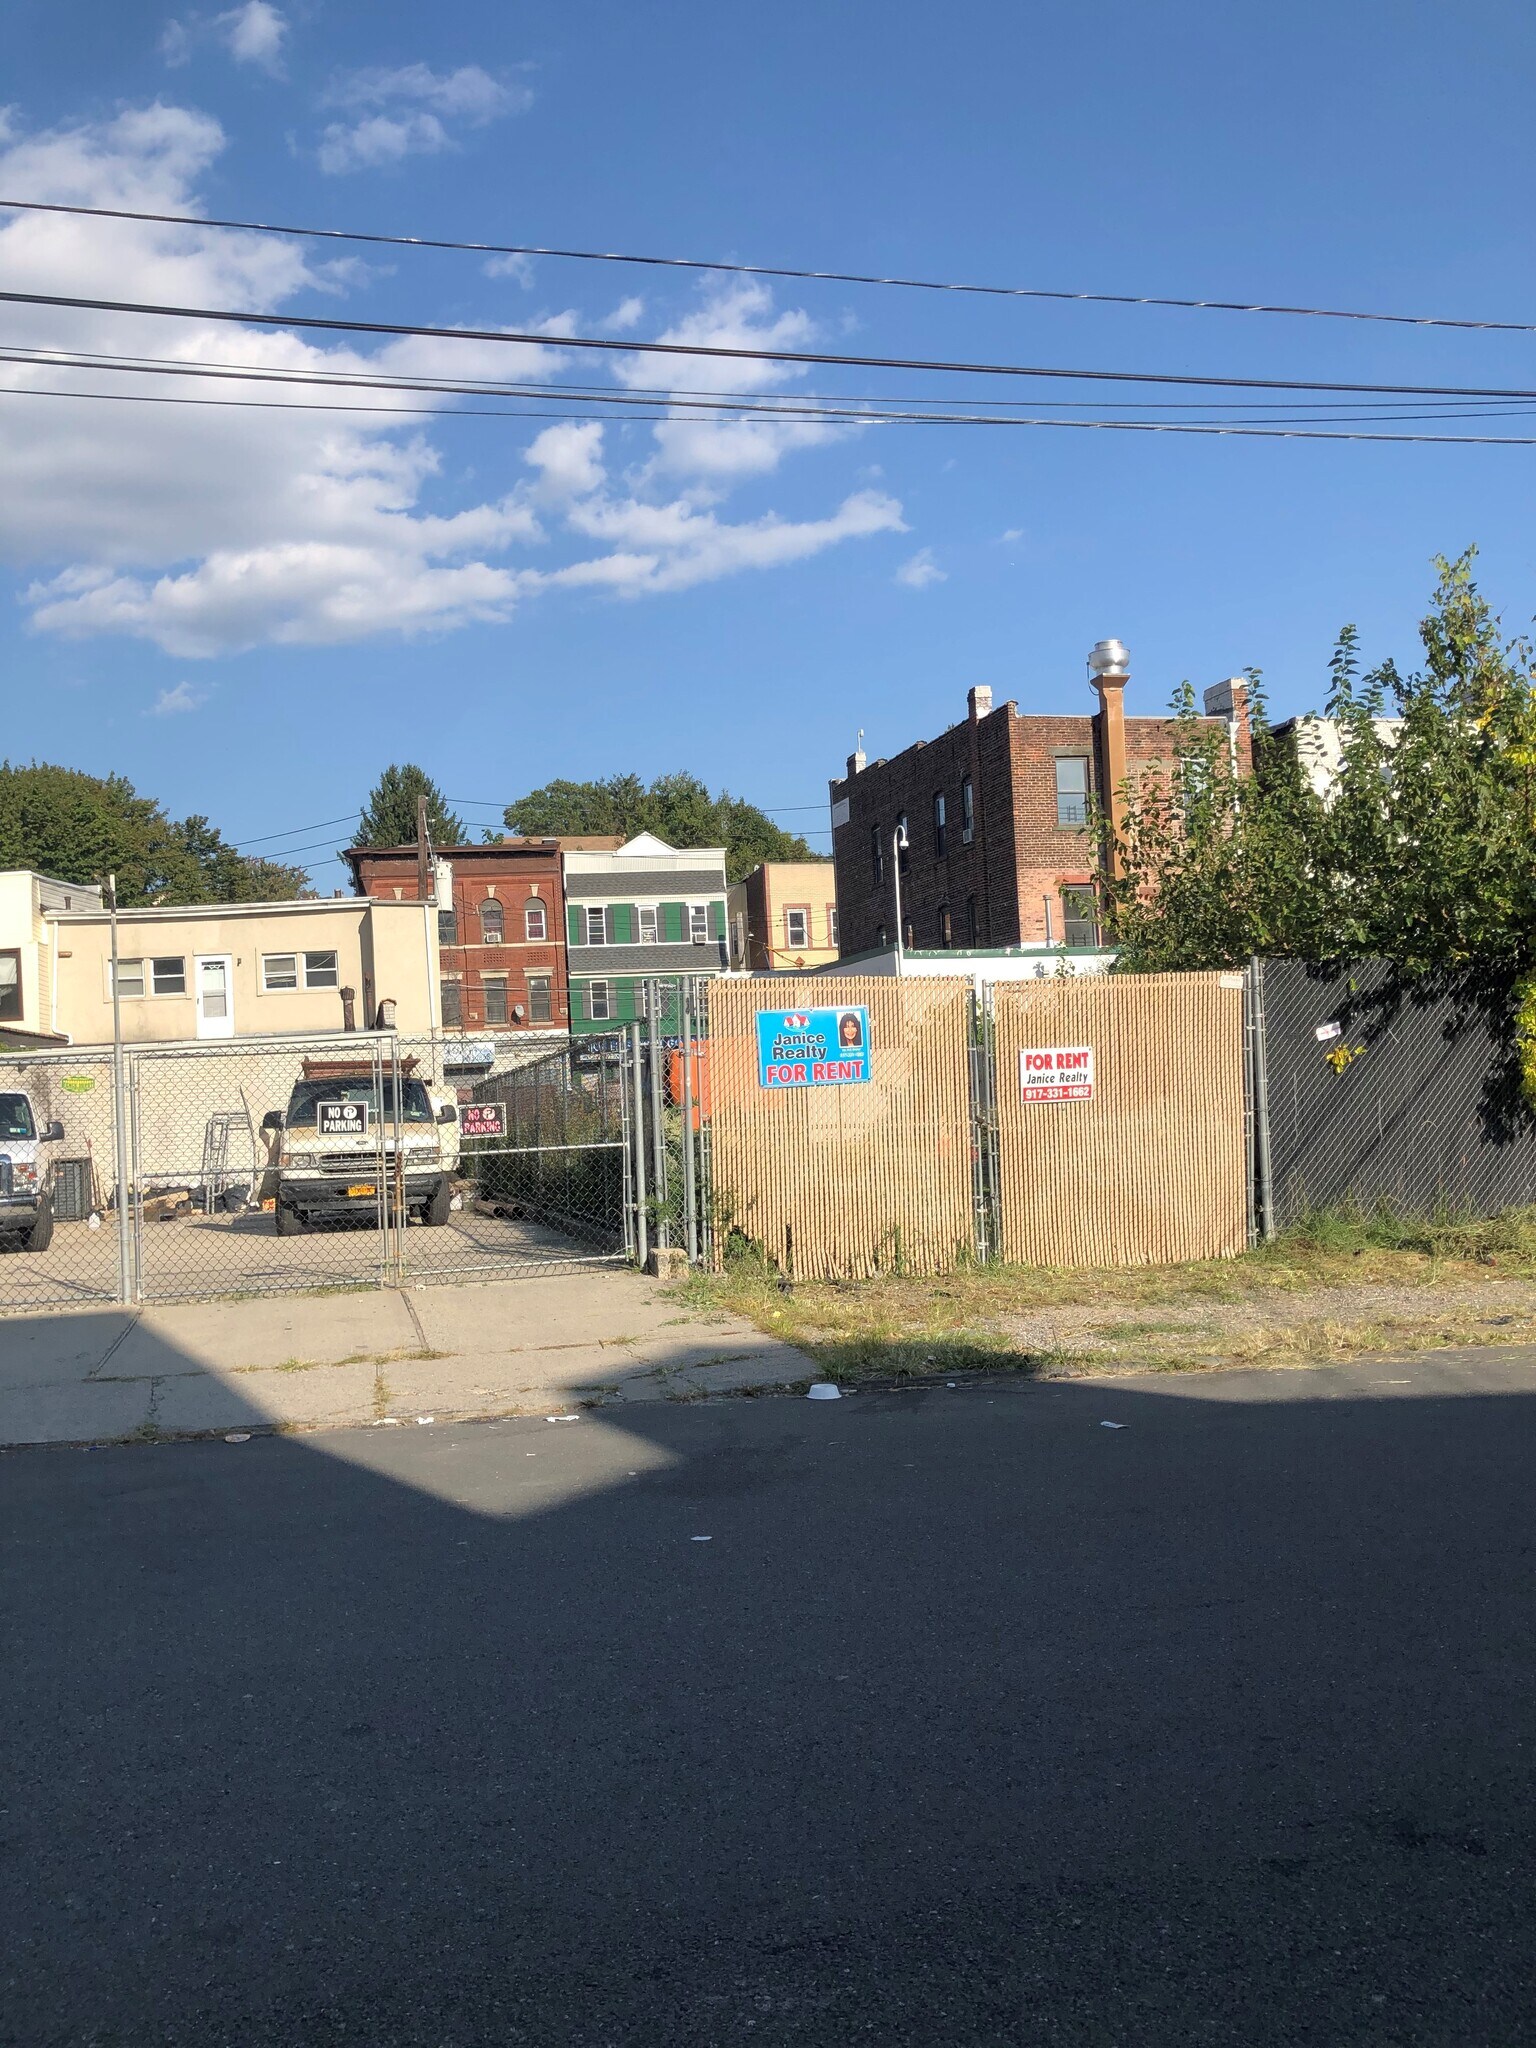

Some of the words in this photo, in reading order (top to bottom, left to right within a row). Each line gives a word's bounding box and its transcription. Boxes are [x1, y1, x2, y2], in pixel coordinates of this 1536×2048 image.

[774, 1032, 825, 1046] Janice
[772, 1045, 827, 1060] Realty
[1025, 1053, 1053, 1071] FOR
[1056, 1052, 1089, 1069] RENT
[767, 1064, 806, 1083] FOR
[812, 1060, 864, 1081] RENT
[1027, 1073, 1055, 1084] Janice
[1059, 1071, 1088, 1084] Realty
[1025, 1086, 1090, 1099] 917-331-1662
[328, 1107, 341, 1119] NO
[468, 1109, 480, 1121] NO
[323, 1119, 362, 1132] PARKING
[464, 1120, 501, 1134] PARKING
